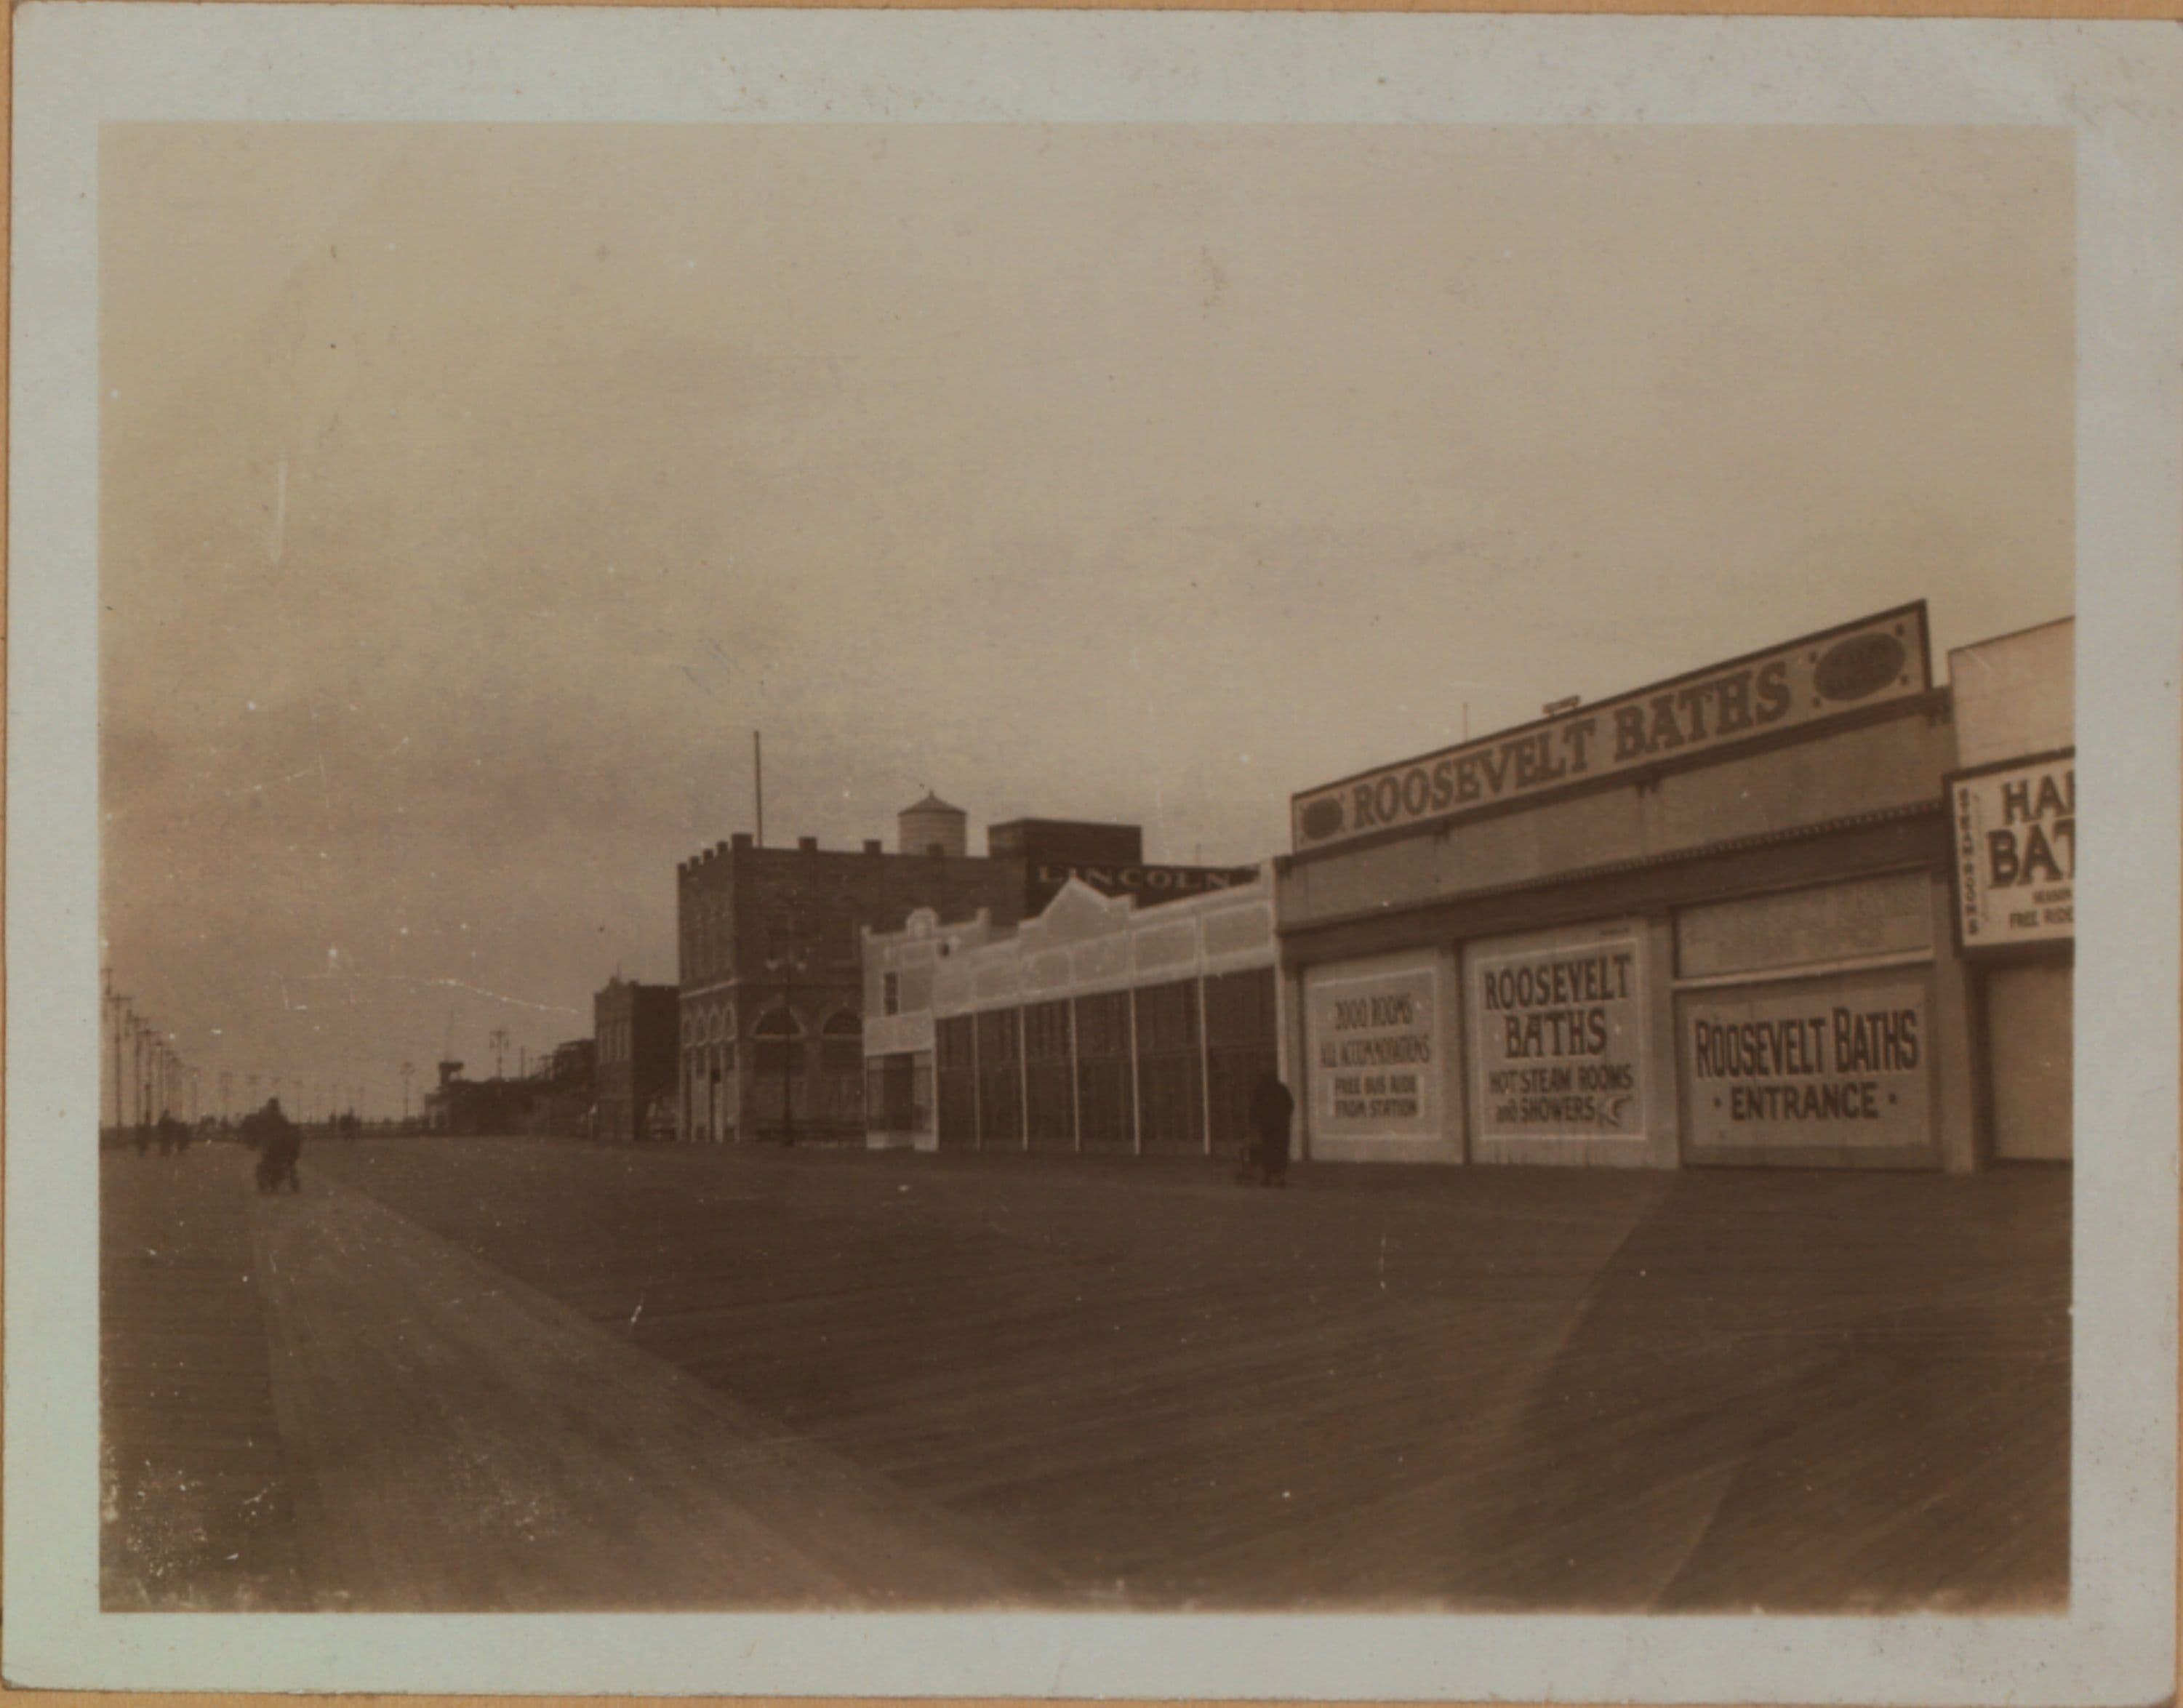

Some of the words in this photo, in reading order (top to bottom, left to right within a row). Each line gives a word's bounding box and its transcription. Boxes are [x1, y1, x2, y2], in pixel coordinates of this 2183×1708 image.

[1355, 718, 1597, 829] ROOSEVELT
[1614, 662, 1790, 762] BATHS
[1485, 953, 1630, 1010] ROOSEVELT
[1505, 1006, 1607, 1058] BATHS
[1695, 1017, 1825, 1078] ROOSEVELT
[1832, 1007, 1918, 1073] BATHS
[1490, 1070, 1518, 1093] HOT
[1520, 1067, 1571, 1093] STEAM
[1578, 1063, 1633, 1090] ROOMS
[1731, 1081, 1878, 1120] ENTRANCE
[1521, 1095, 1595, 1122] SHOWERS
